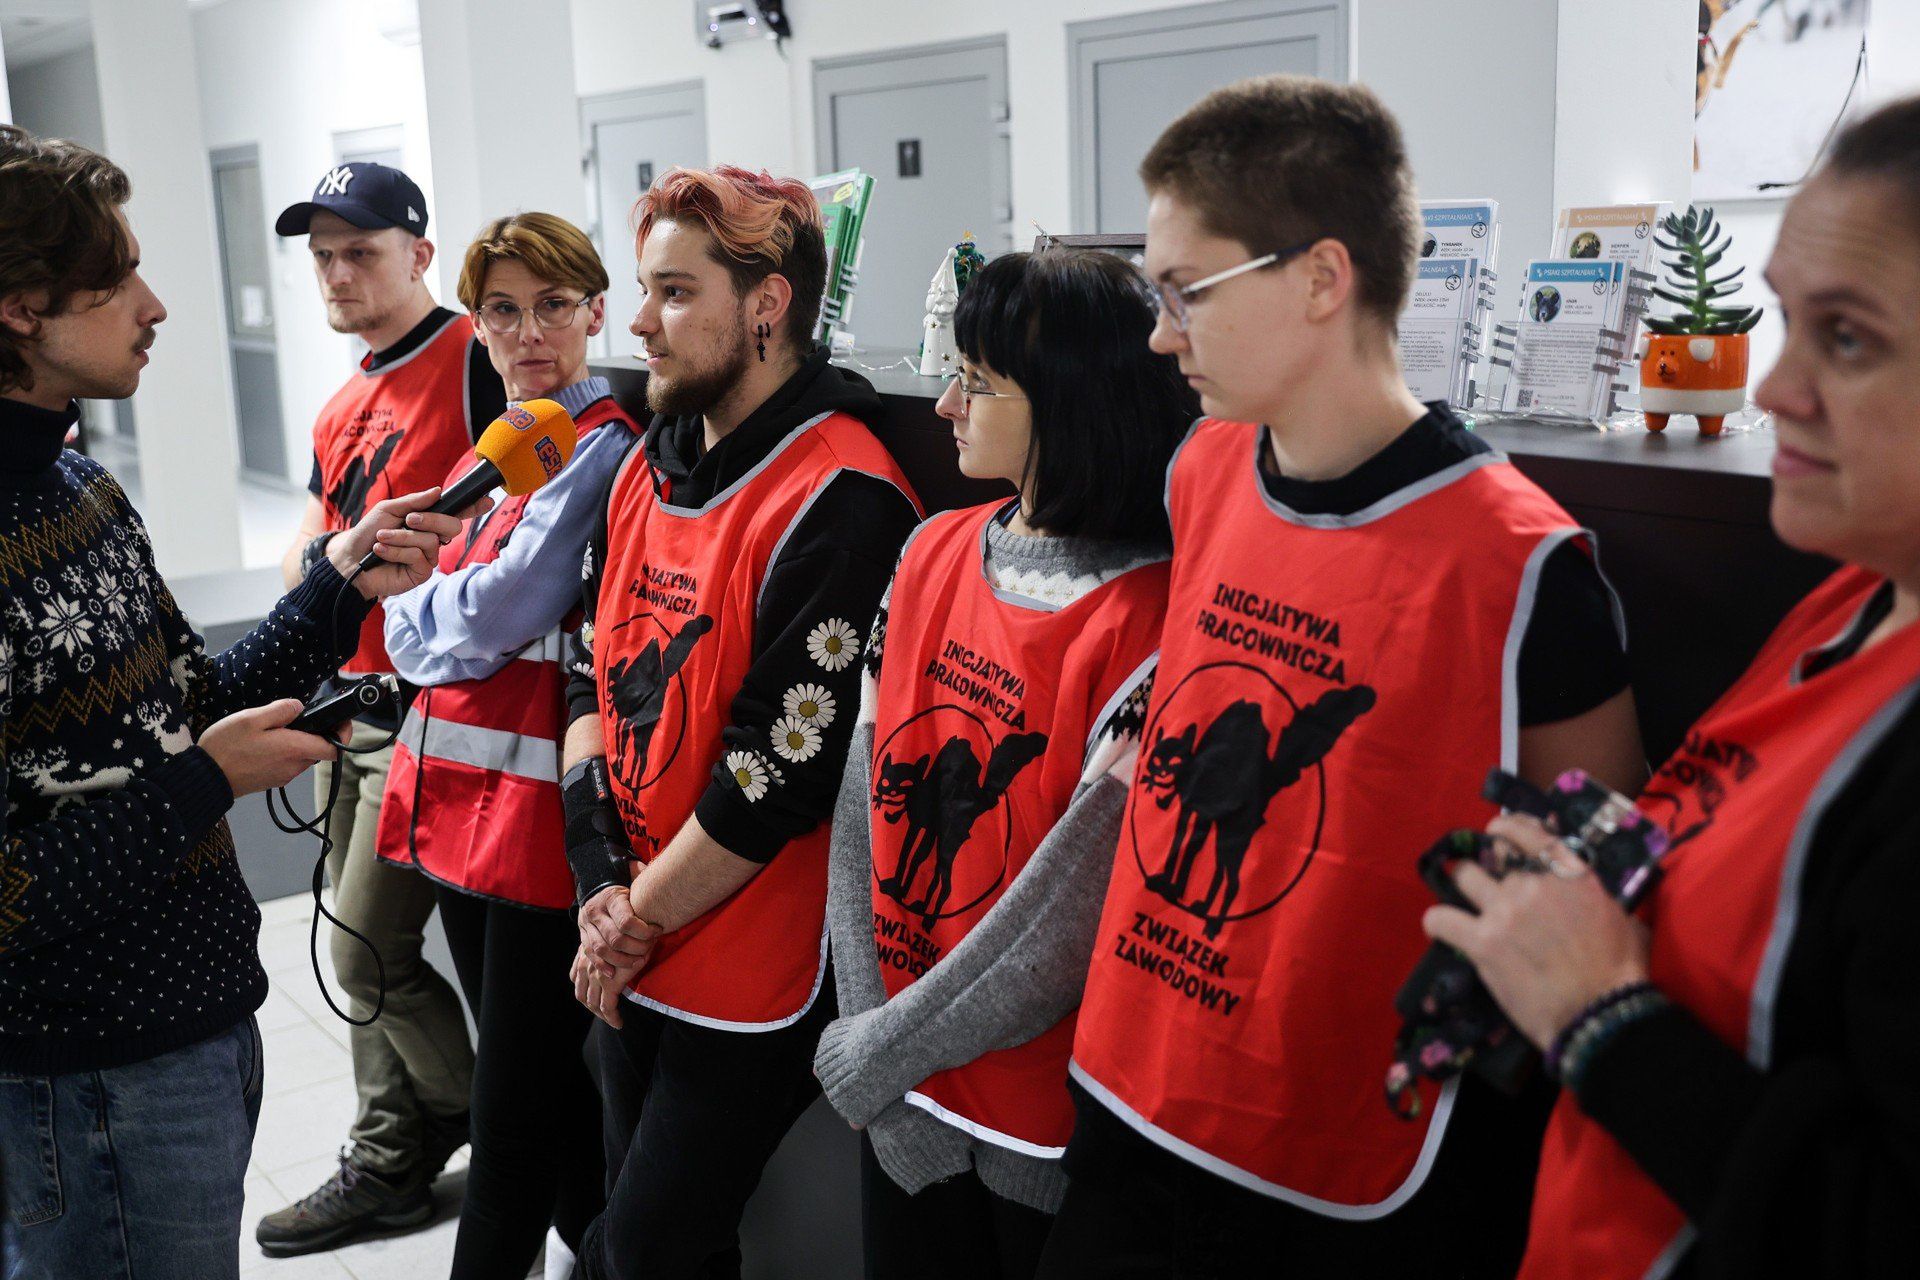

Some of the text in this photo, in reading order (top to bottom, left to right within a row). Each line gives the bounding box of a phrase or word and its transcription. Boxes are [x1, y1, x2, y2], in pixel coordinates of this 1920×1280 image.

[318, 166, 353, 196] NY
[1561, 268, 1596, 276] SZPITALNIAKI
[1196, 610, 1346, 684] PRACOWNICZA
[1213, 583, 1341, 649] INICJATYWA
[925, 659, 1026, 731] PRACOWNICZA
[943, 639, 1026, 701] INICJATYWA
[1114, 935, 1241, 1017] ZAWODOWY
[1131, 911, 1231, 978] ZWIĄZEK
